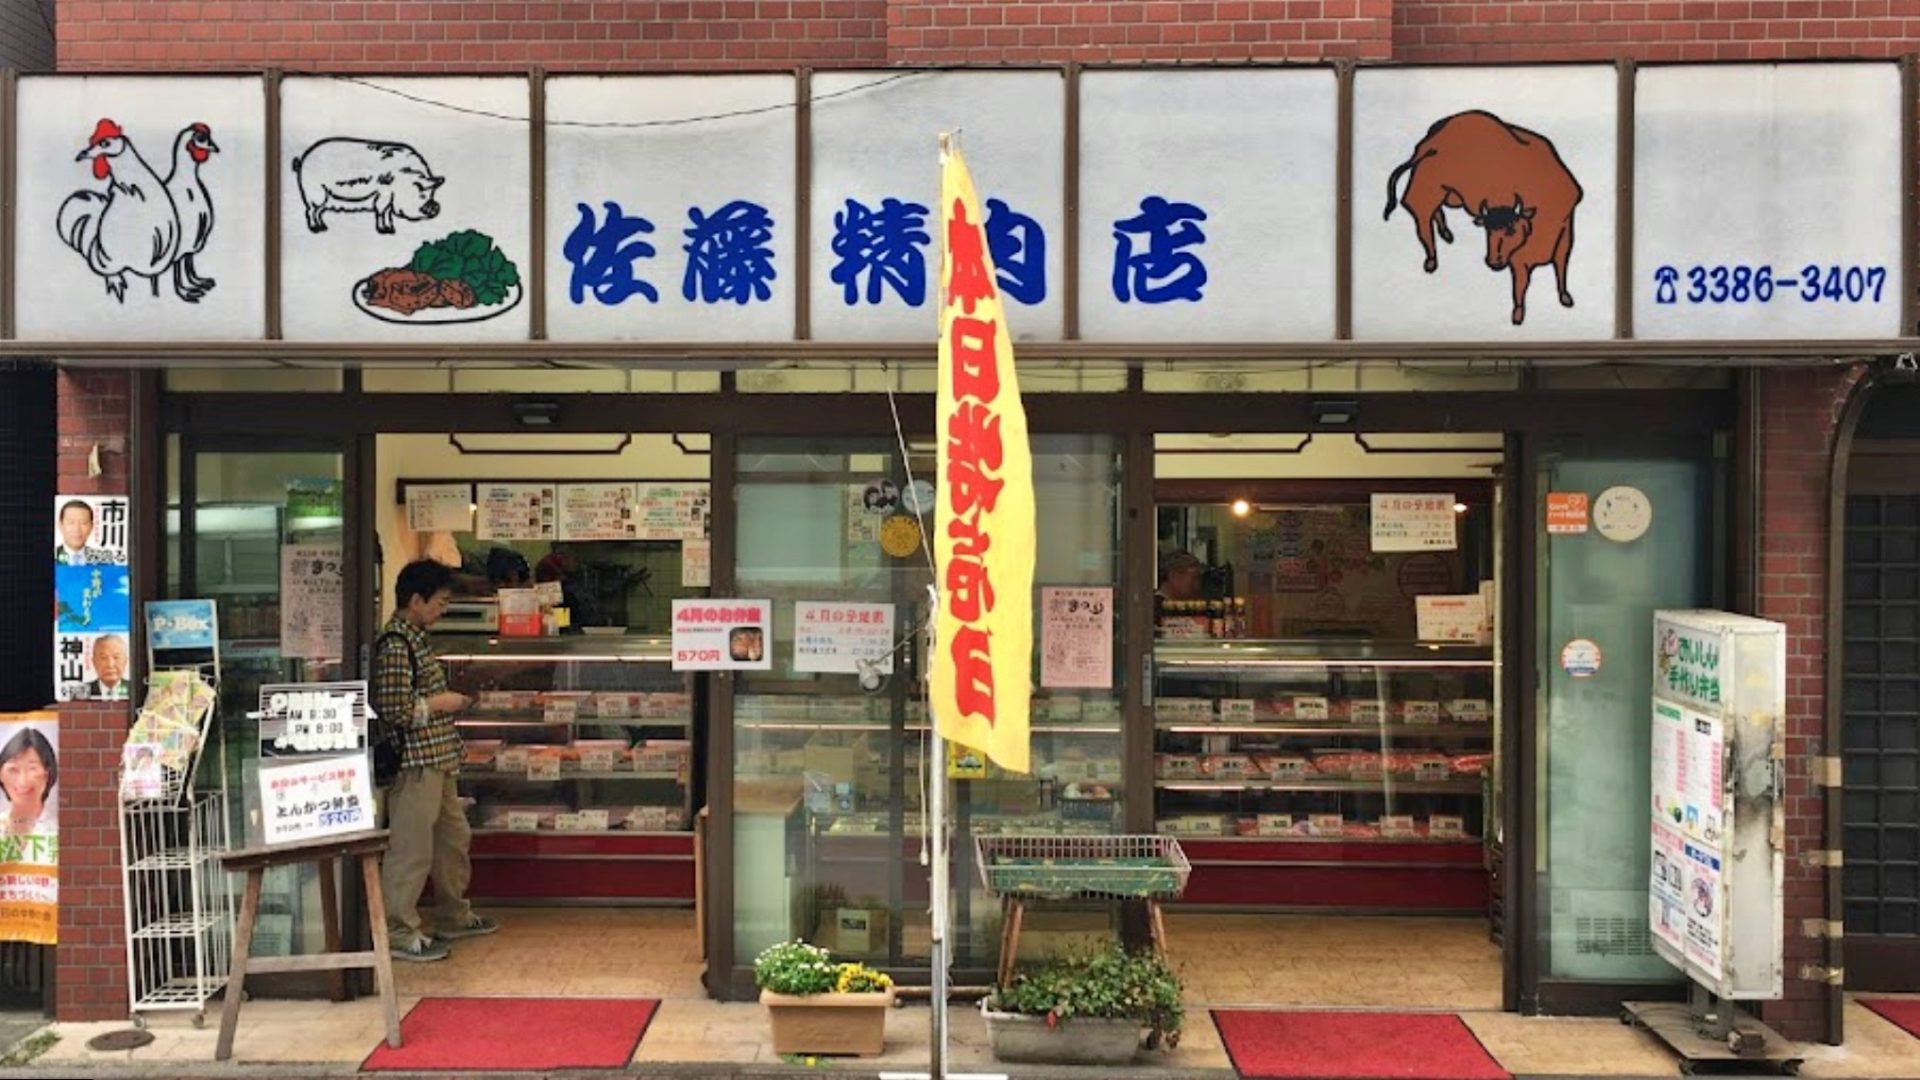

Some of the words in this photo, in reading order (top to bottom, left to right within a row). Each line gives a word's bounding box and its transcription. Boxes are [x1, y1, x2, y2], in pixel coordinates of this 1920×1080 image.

[1686, 264, 1886, 303] 3386-3407
[100, 499, 126, 548] 市川
[60, 636, 83, 683] 神山
